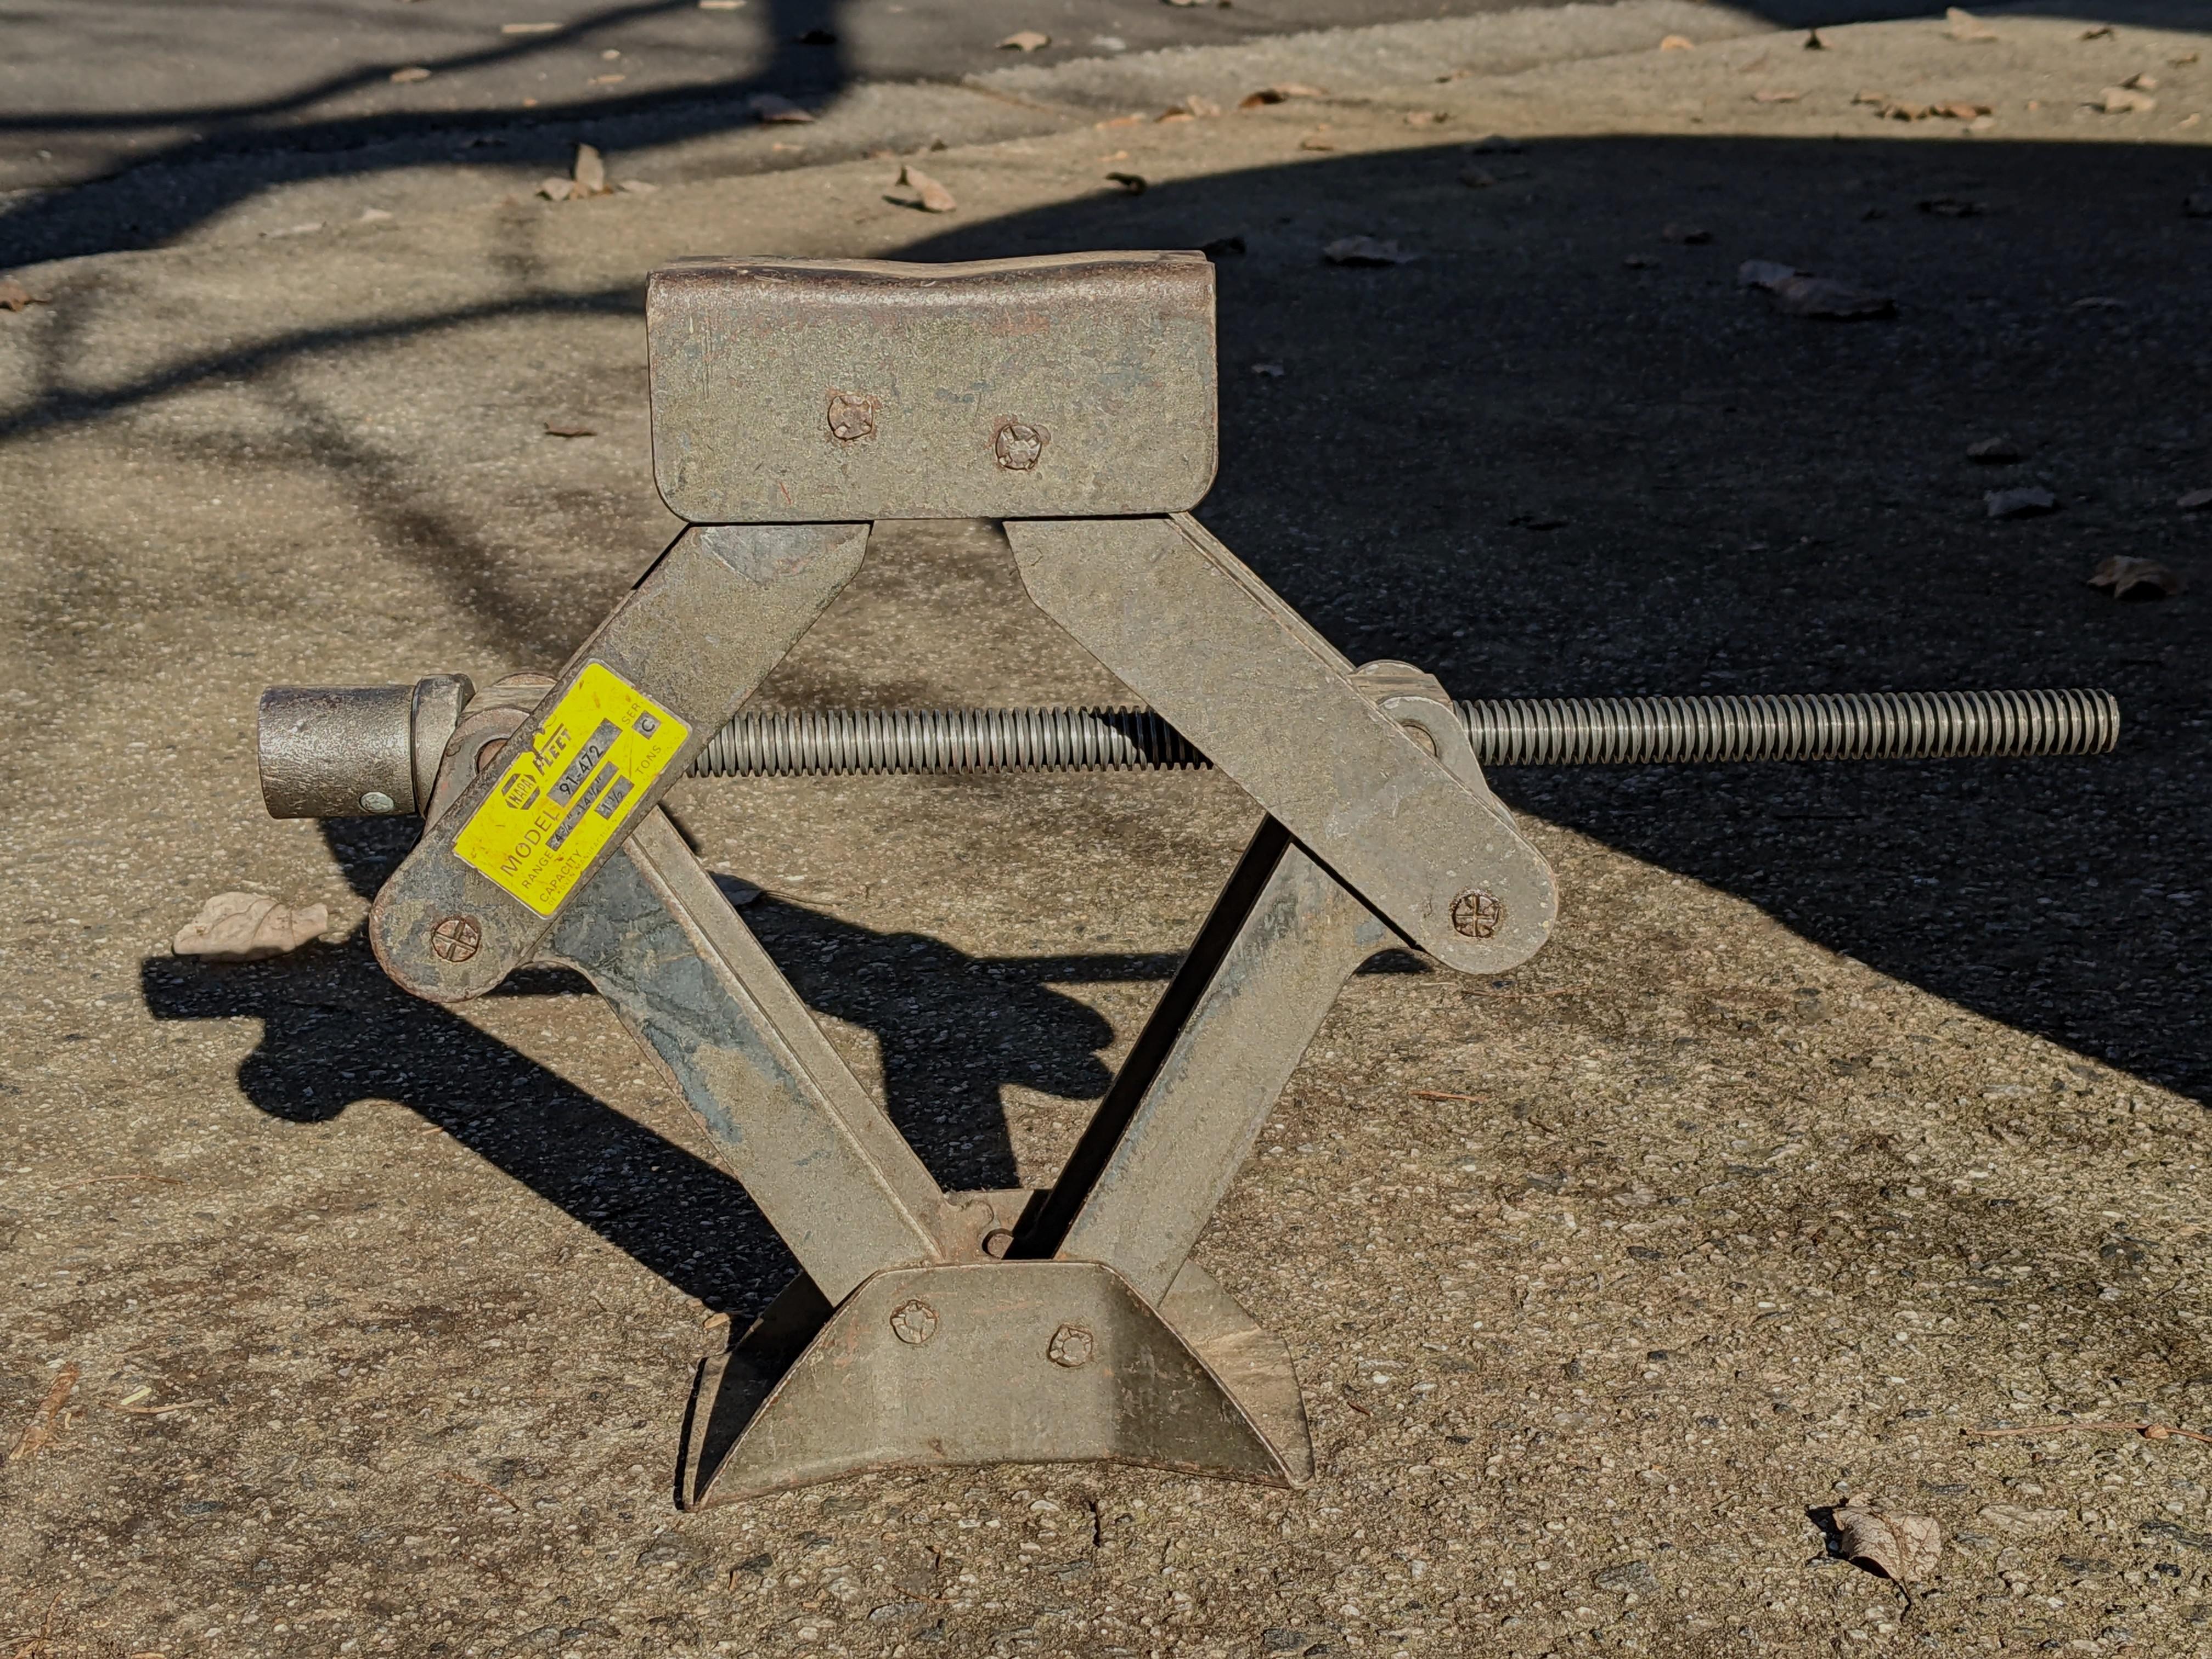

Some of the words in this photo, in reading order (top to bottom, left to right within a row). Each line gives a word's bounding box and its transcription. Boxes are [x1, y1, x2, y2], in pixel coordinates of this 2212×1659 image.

[620, 702, 641, 725] SER
[641, 719, 655, 733] C
[528, 721, 577, 776] FLEET
[498, 803, 562, 878] MODEL
[557, 743, 604, 797] 91-472
[507, 776, 534, 805] NAPA
[538, 848, 584, 904] CAPACITY
[634, 743, 663, 776] TONS
[520, 849, 554, 889] RANGE
